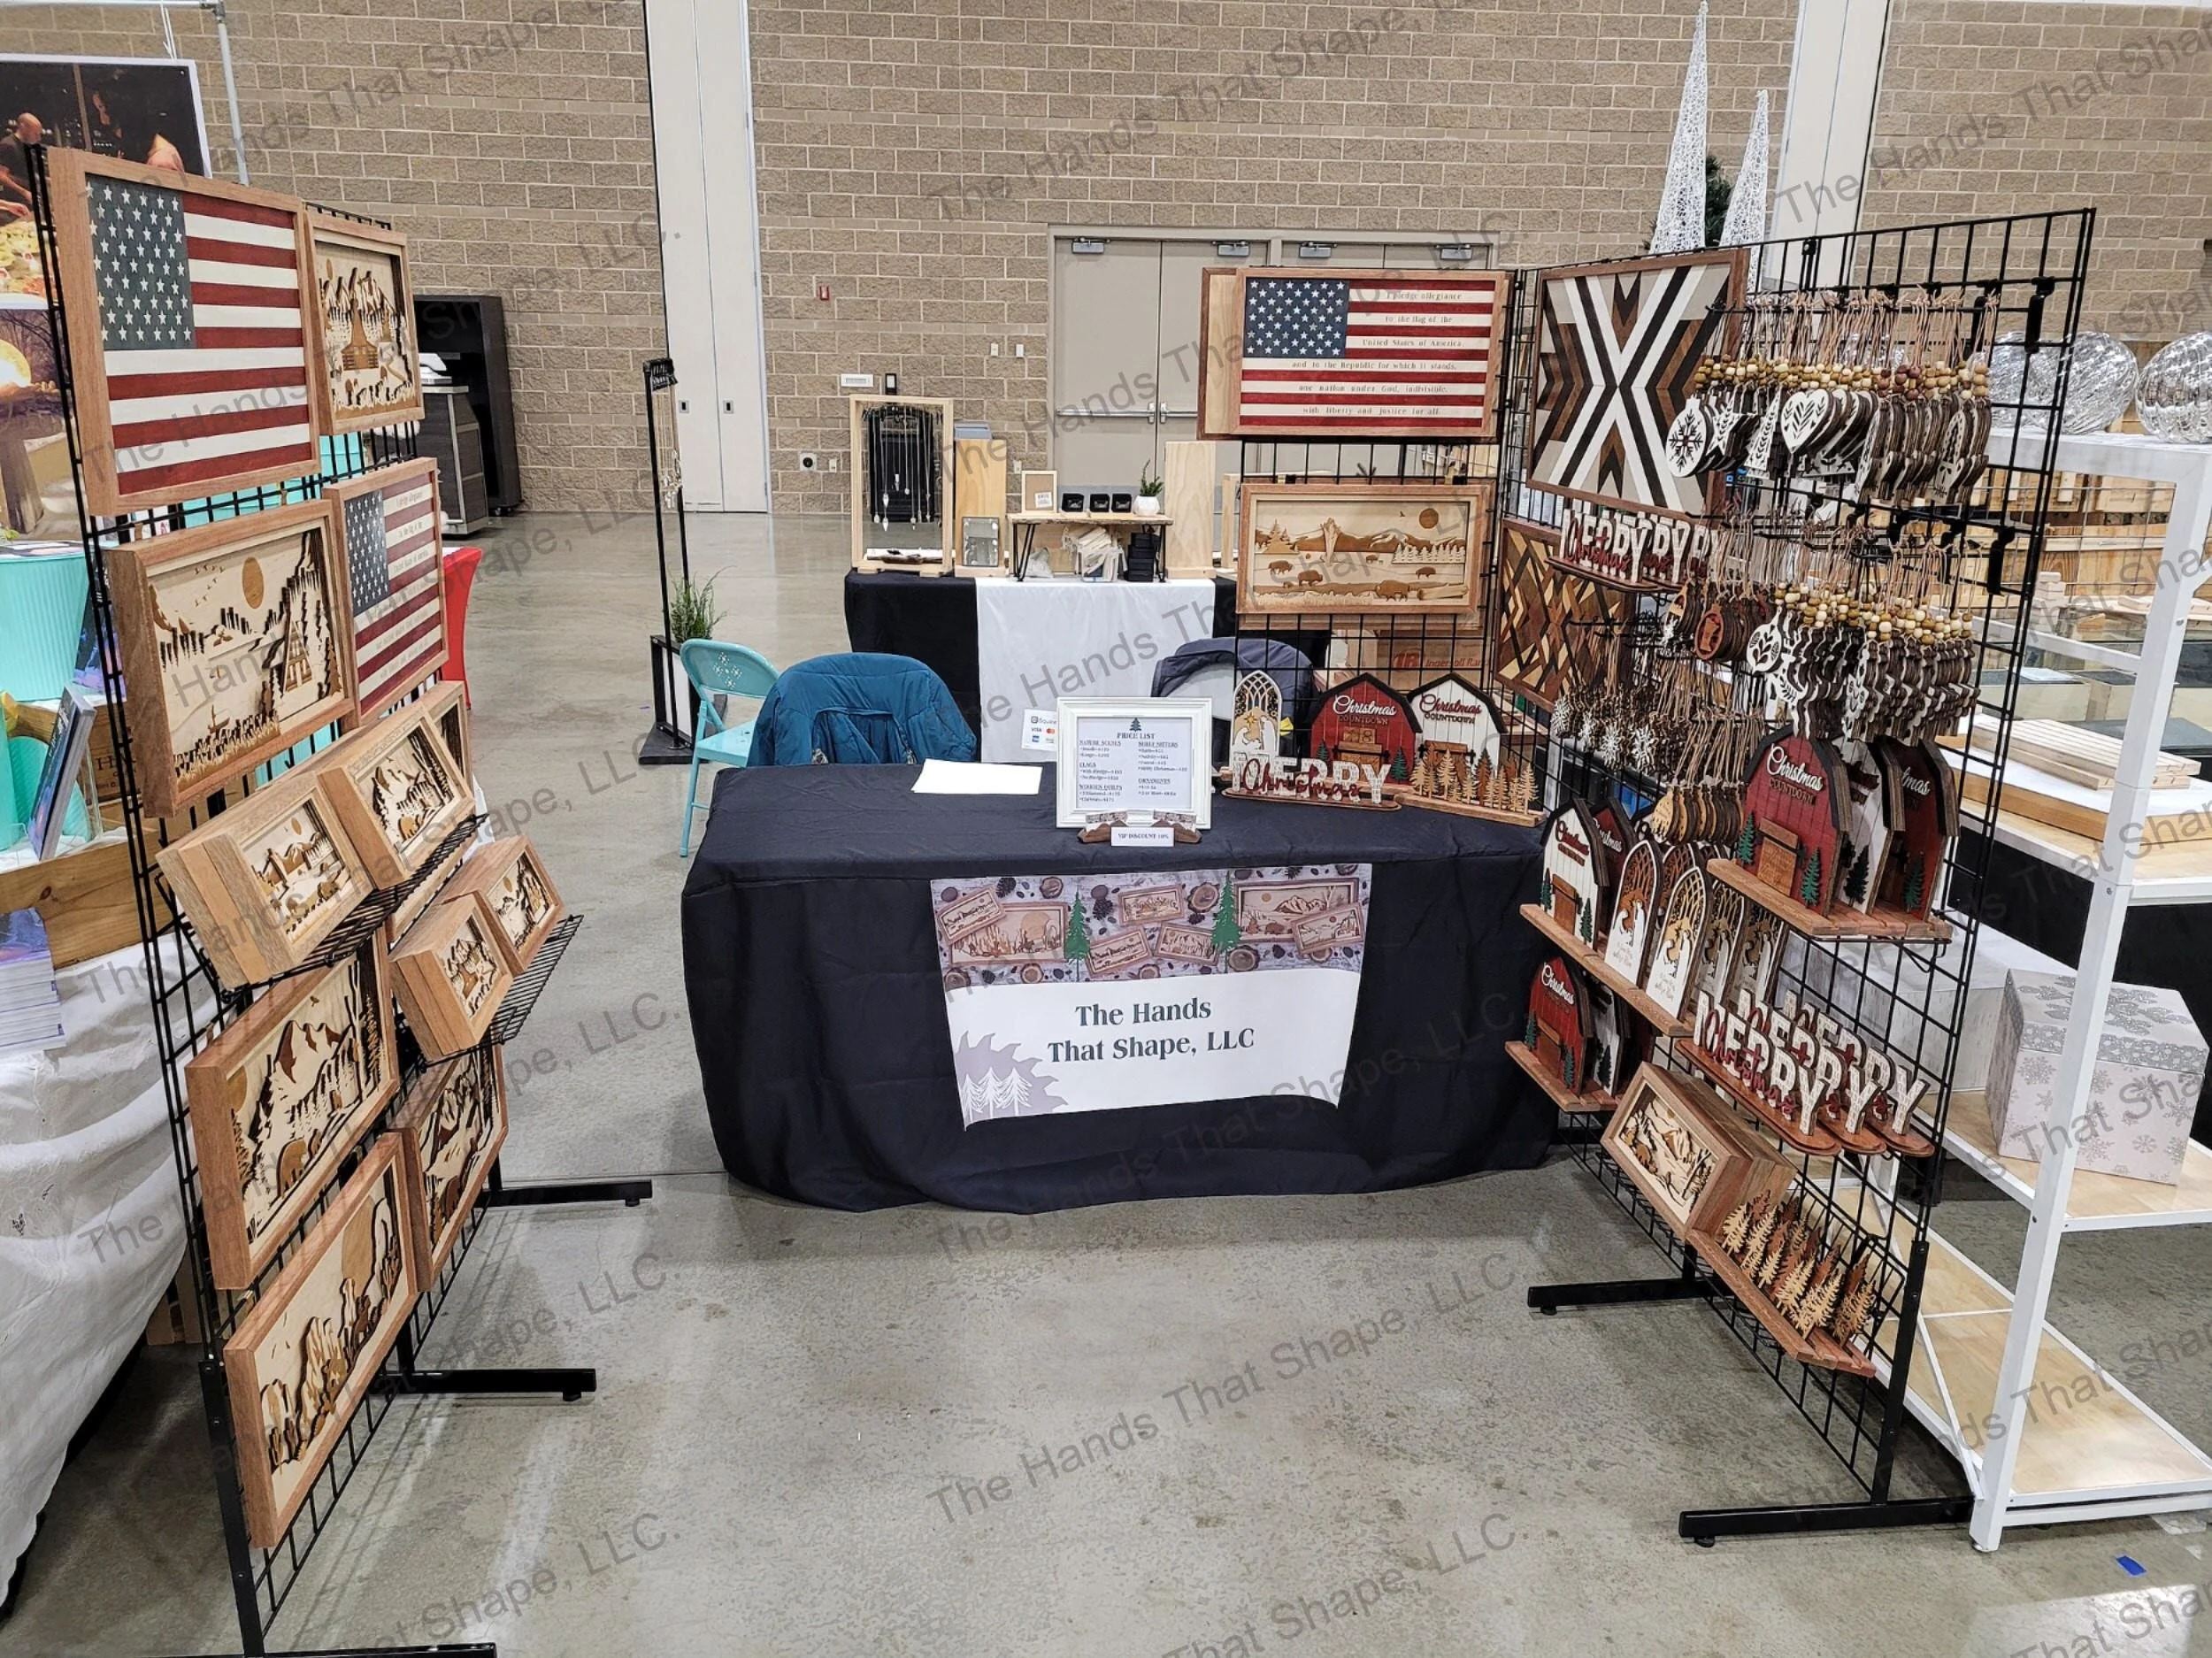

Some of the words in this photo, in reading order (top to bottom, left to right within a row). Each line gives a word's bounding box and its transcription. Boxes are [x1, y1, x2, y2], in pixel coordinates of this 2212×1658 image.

[1421, 291, 1462, 301] allegiance
[1340, 361, 1374, 370] Republic
[1379, 407, 1407, 416] justice
[1332, 694, 1398, 717] Christmas
[1418, 693, 1483, 715] Christmas
[1338, 715, 1389, 726] COUNTDOWN
[1424, 712, 1477, 725] COUNTDOWN
[1766, 742, 1824, 792] Christmas
[1075, 1003, 1124, 1027] The
[1133, 997, 1211, 1025] Hands
[1048, 1039, 1104, 1063] That
[1112, 1033, 1197, 1062] Shape,
[1207, 1027, 1255, 1052] LLC
